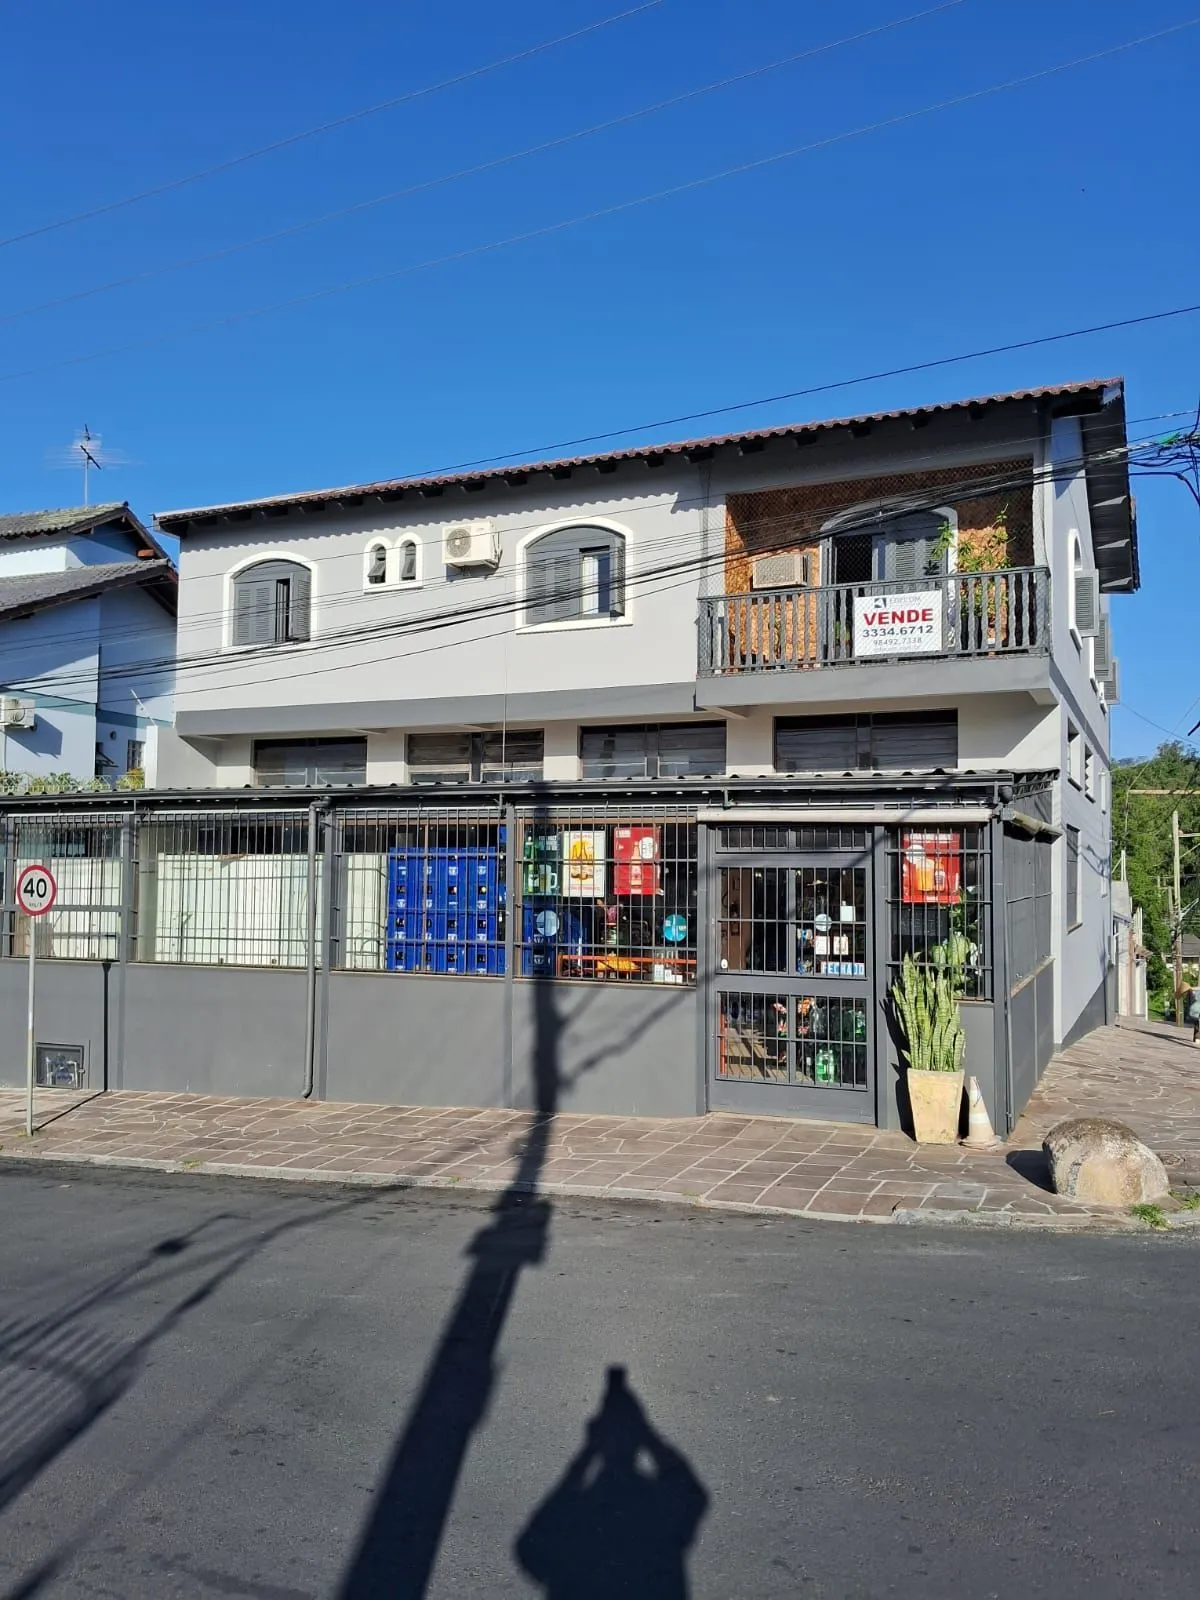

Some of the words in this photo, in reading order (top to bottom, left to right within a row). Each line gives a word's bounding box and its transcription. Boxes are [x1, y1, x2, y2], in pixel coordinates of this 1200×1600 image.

[863, 609, 934, 625] VENDE
[862, 625, 934, 637] 3334.6712
[23, 877, 47, 898] 40
